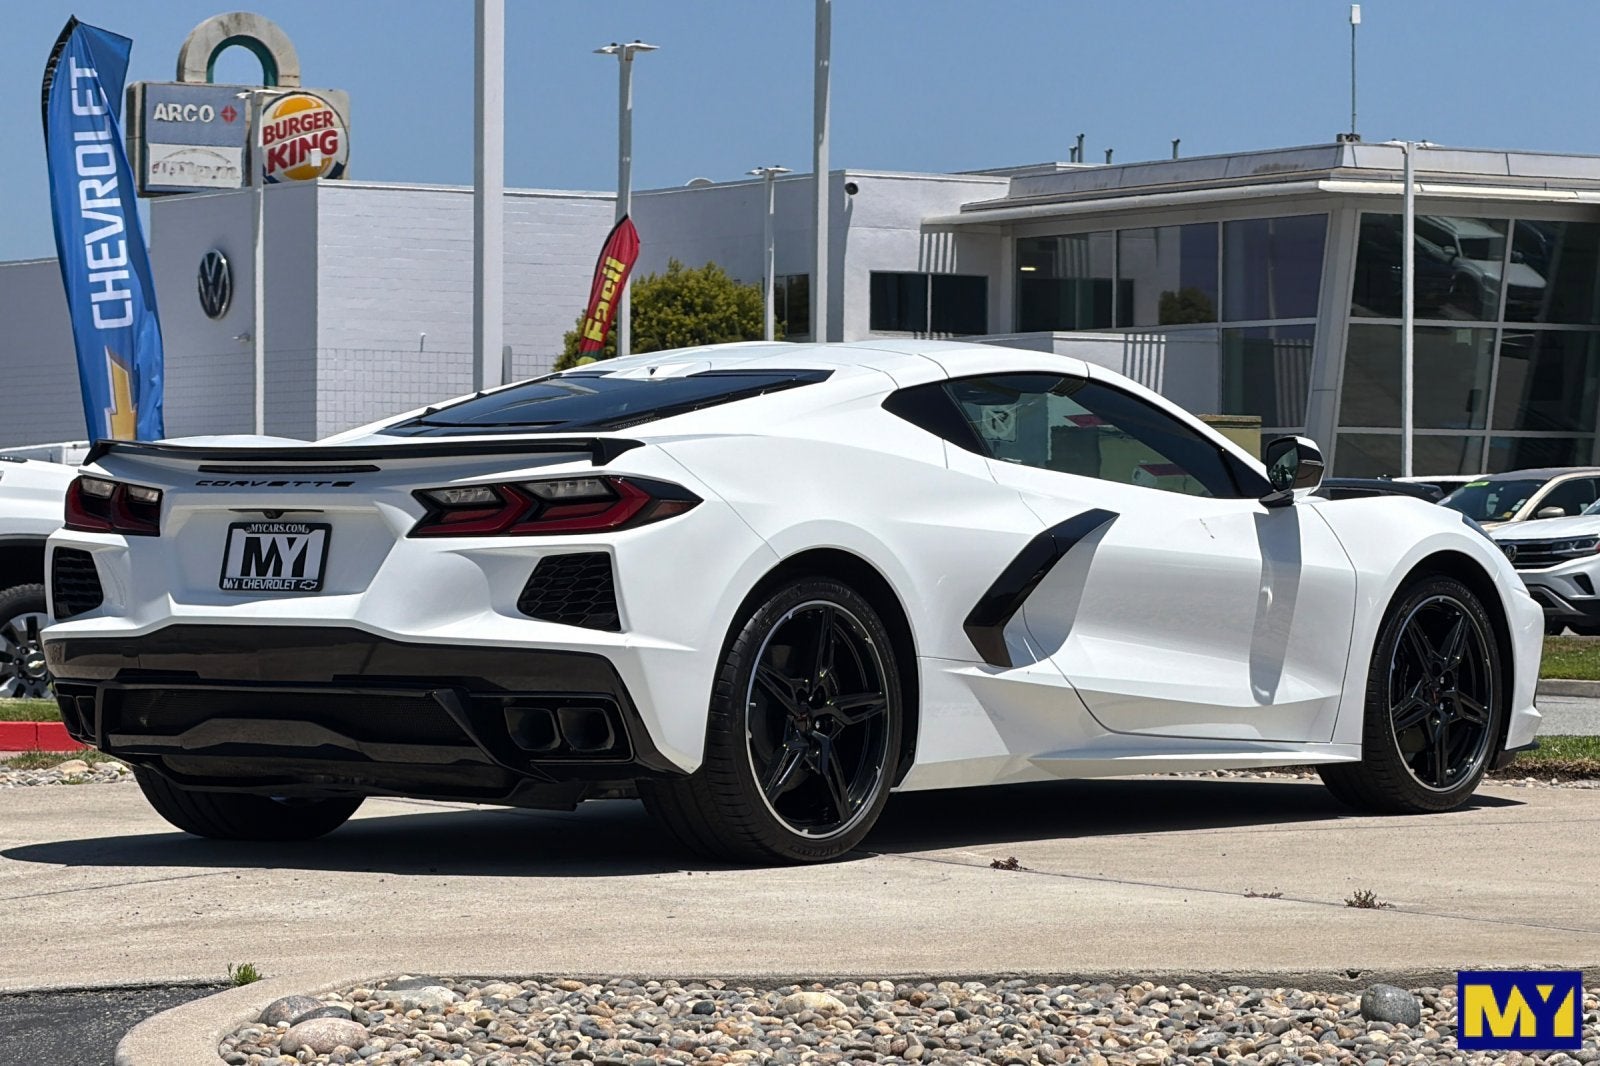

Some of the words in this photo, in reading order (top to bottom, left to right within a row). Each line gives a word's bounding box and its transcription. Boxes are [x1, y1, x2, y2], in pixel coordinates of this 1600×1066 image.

[153, 103, 215, 123] ARCO
[263, 110, 334, 146] BURGER
[267, 129, 338, 174] KING
[69, 56, 133, 330] CHEVROLET
[195, 480, 355, 488] CORVETTE
[250, 523, 306, 533] MYCARS.COM
[240, 536, 309, 578] MY
[223, 578, 239, 589] MY
[242, 578, 297, 590] CHEVROLET
